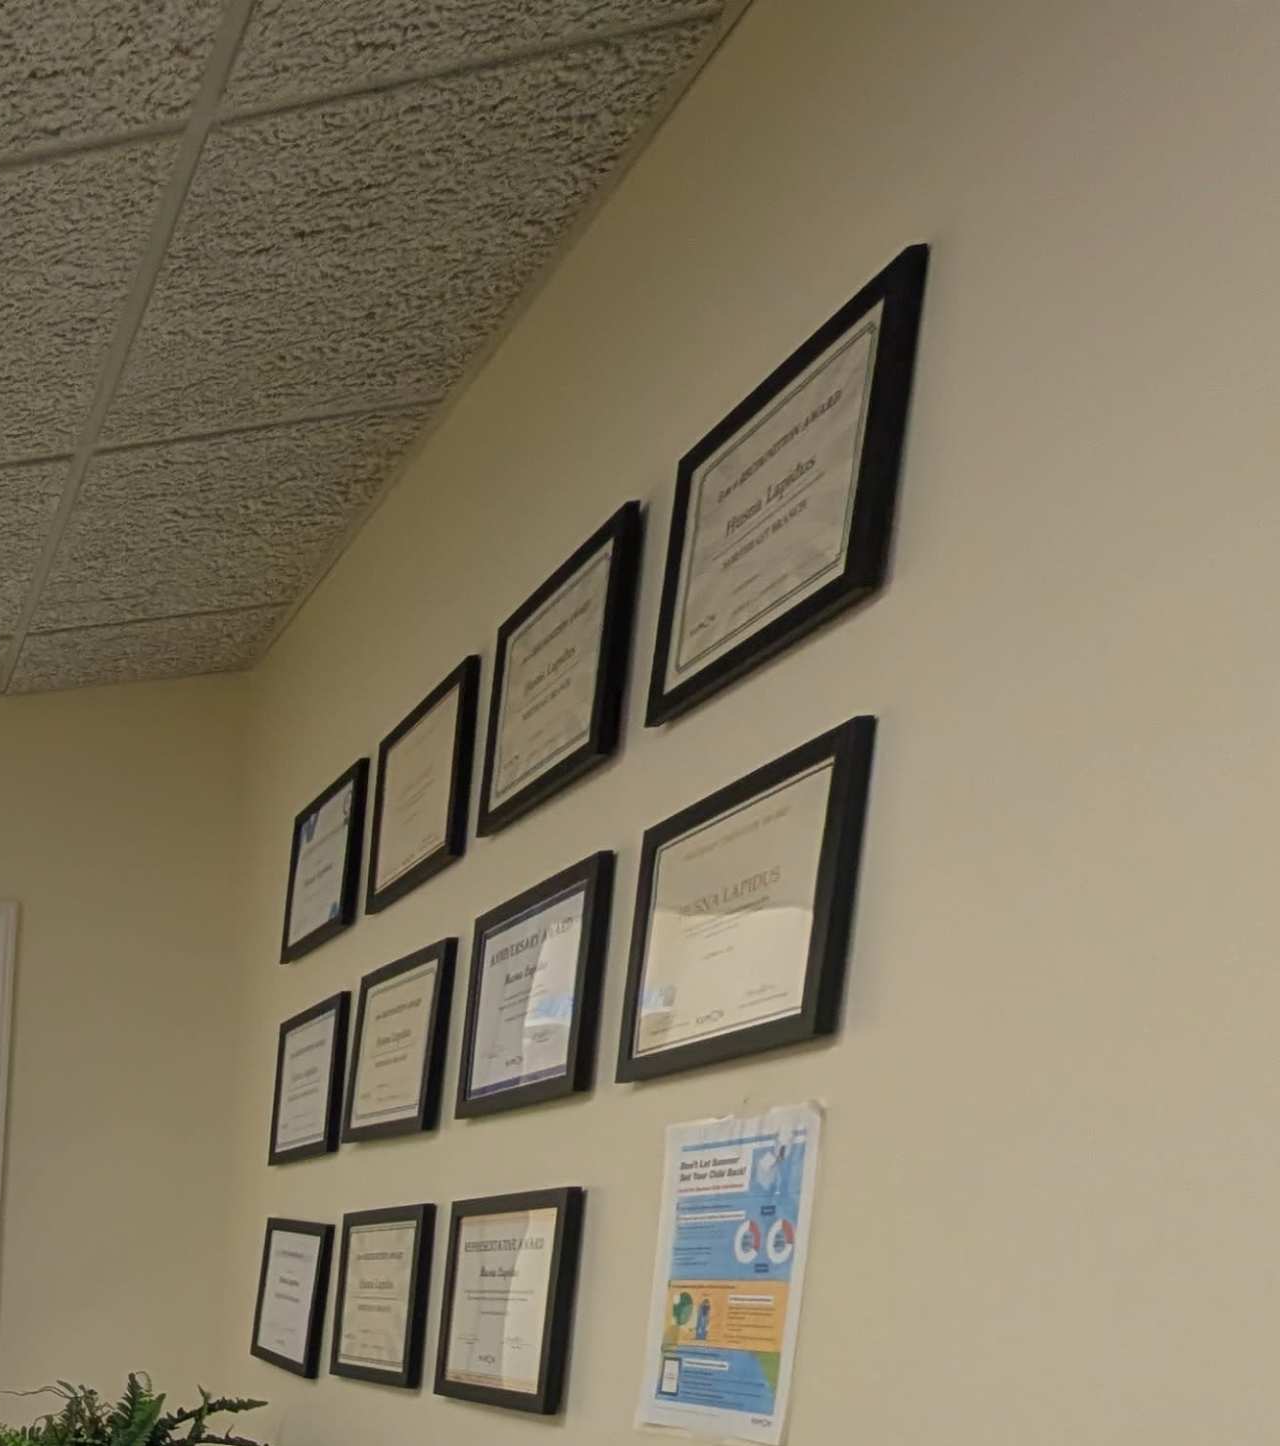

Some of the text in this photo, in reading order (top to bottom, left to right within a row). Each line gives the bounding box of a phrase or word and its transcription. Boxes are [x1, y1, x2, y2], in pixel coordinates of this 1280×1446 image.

[679, 1160, 699, 1171] Don't
[699, 1159, 712, 1170] Let
[726, 1166, 748, 1177] Back!
